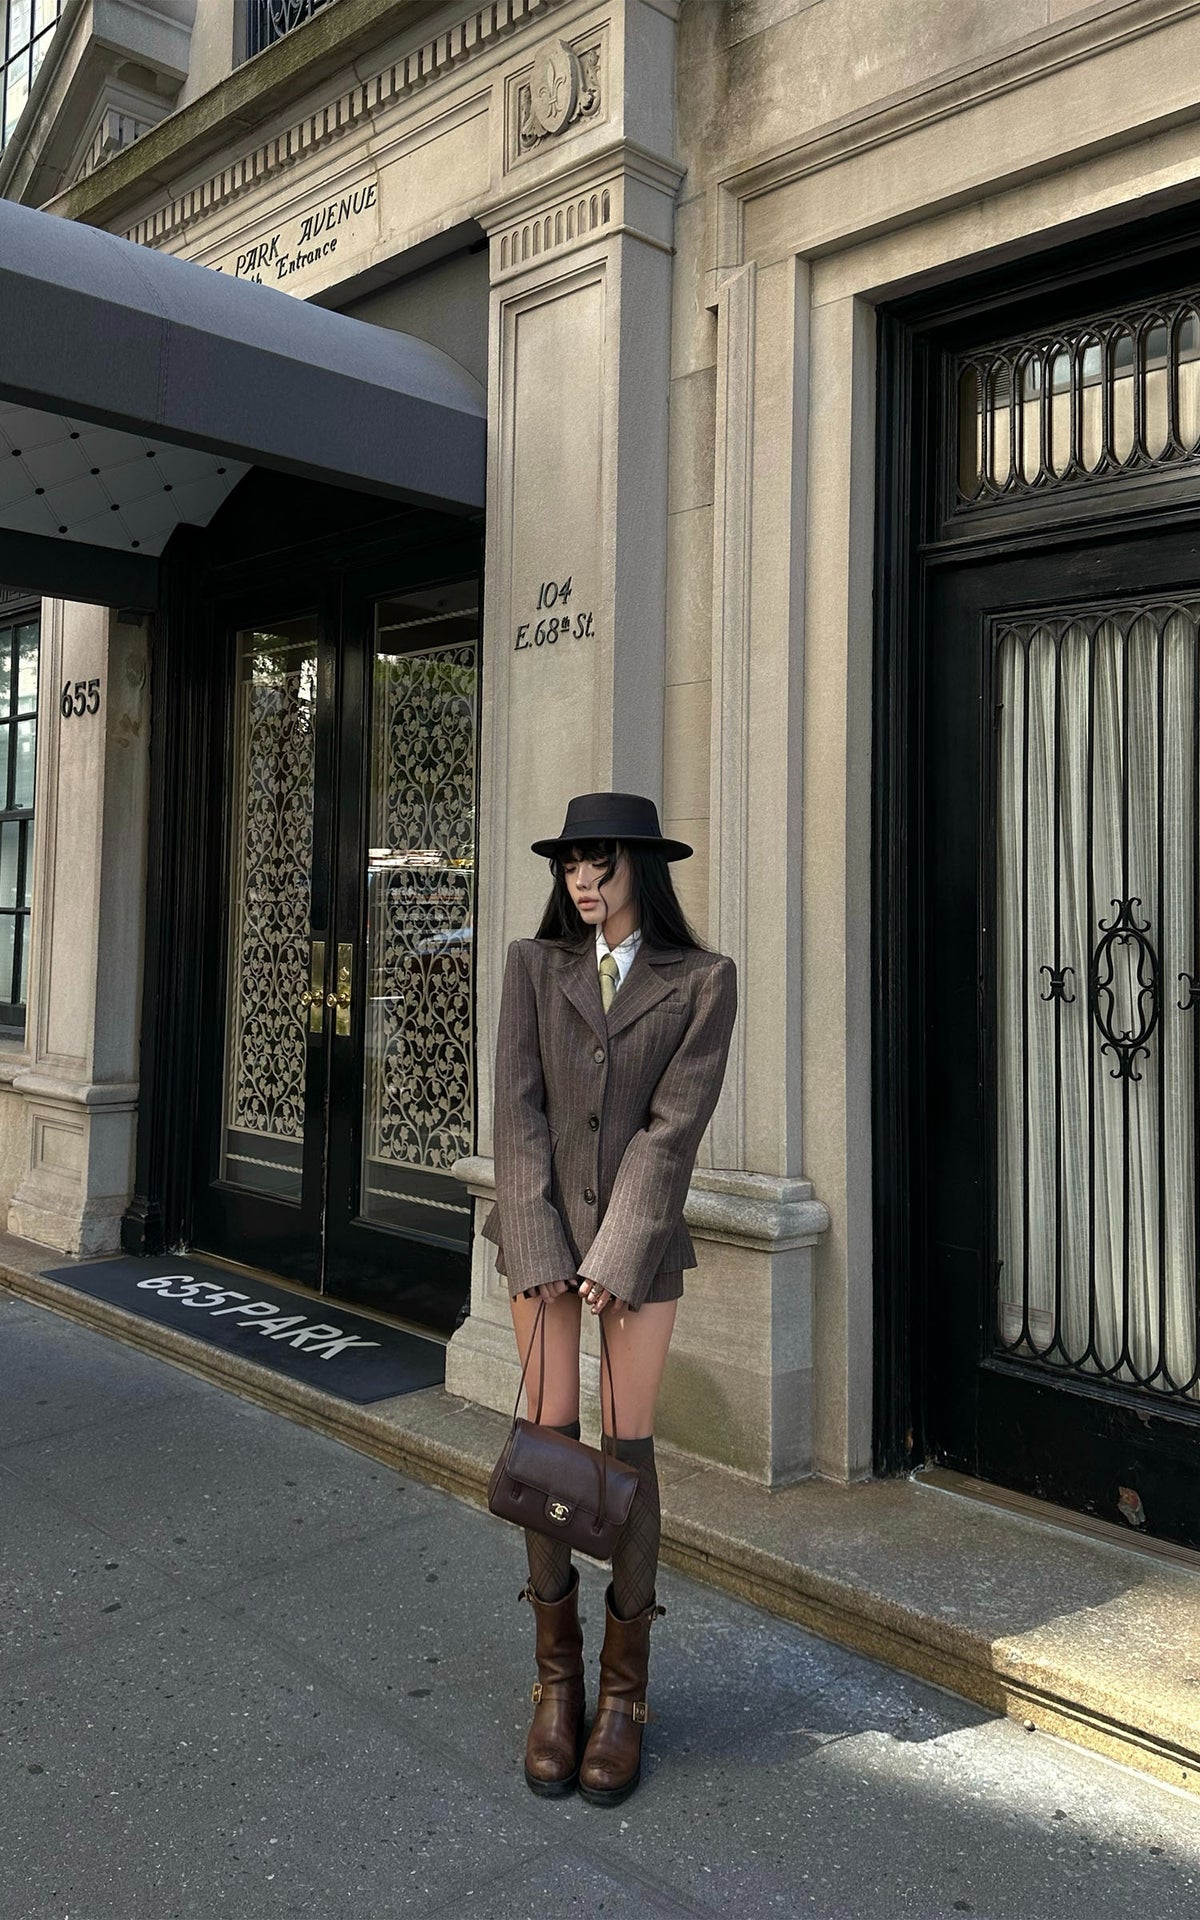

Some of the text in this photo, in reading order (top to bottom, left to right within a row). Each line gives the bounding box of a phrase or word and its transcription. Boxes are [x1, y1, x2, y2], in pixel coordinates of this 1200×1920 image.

[235, 183, 378, 278] PARK AVENUE
[276, 238, 338, 280] Entrance
[536, 576, 573, 610] 104
[572, 612, 595, 640] St.
[61, 678, 100, 719] 655
